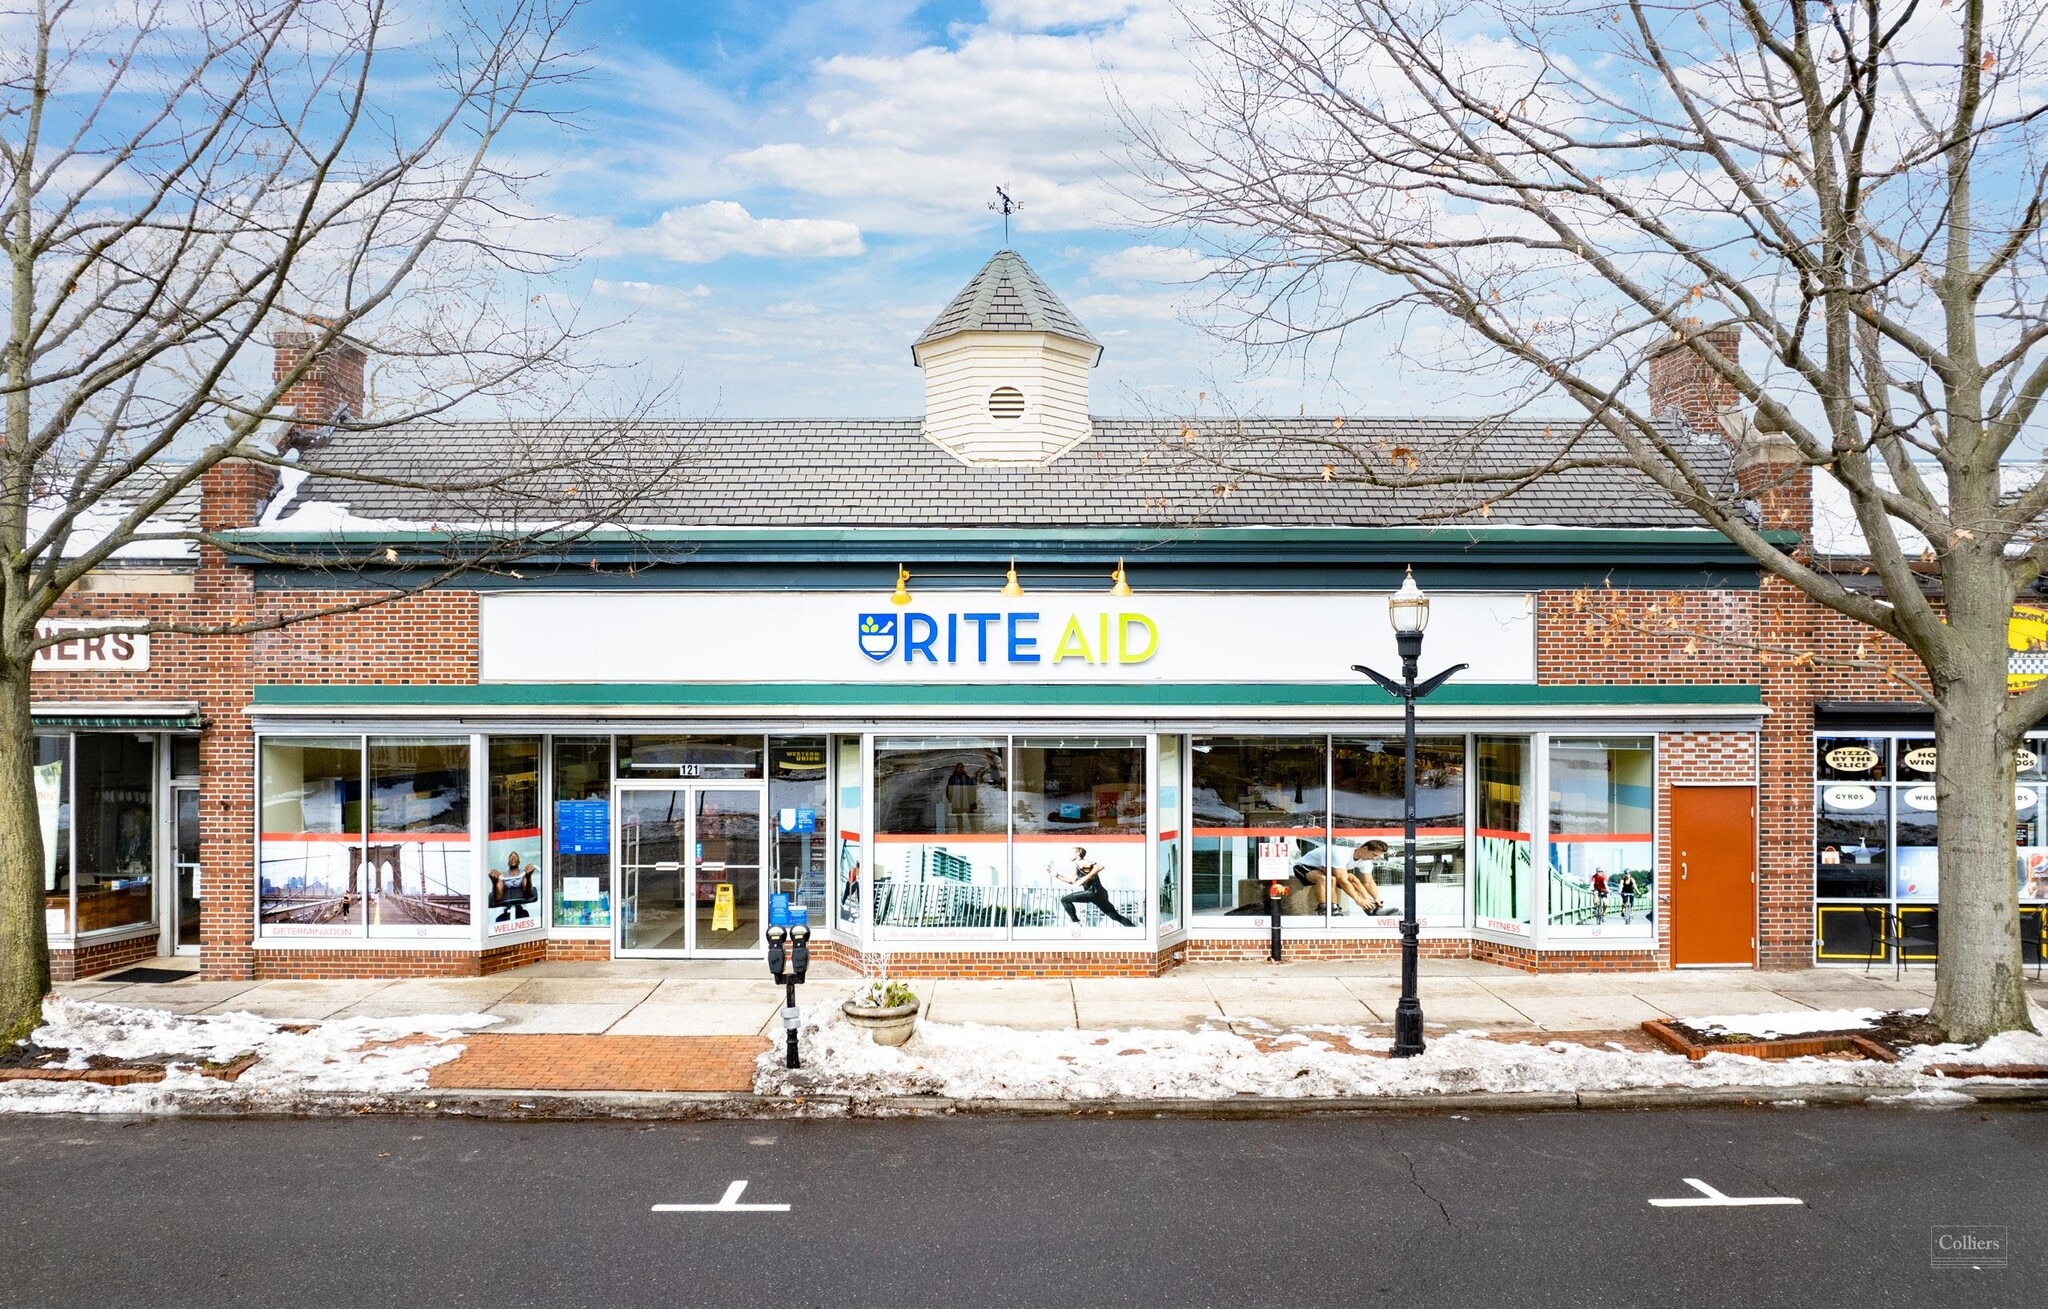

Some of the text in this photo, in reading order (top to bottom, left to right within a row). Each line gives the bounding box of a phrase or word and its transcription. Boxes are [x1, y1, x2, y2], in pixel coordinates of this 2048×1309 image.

[2011, 607, 2048, 625] izzeri
[33, 627, 135, 661] NERS
[904, 612, 1159, 663] RITE AID
[681, 764, 699, 775] 121
[2016, 759, 2035, 767] OGS
[494, 919, 535, 933] WELLNESS
[1377, 917, 1428, 926] WELSS
[1488, 920, 1521, 933] FITNESS
[272, 927, 352, 936] DETERMINATION
